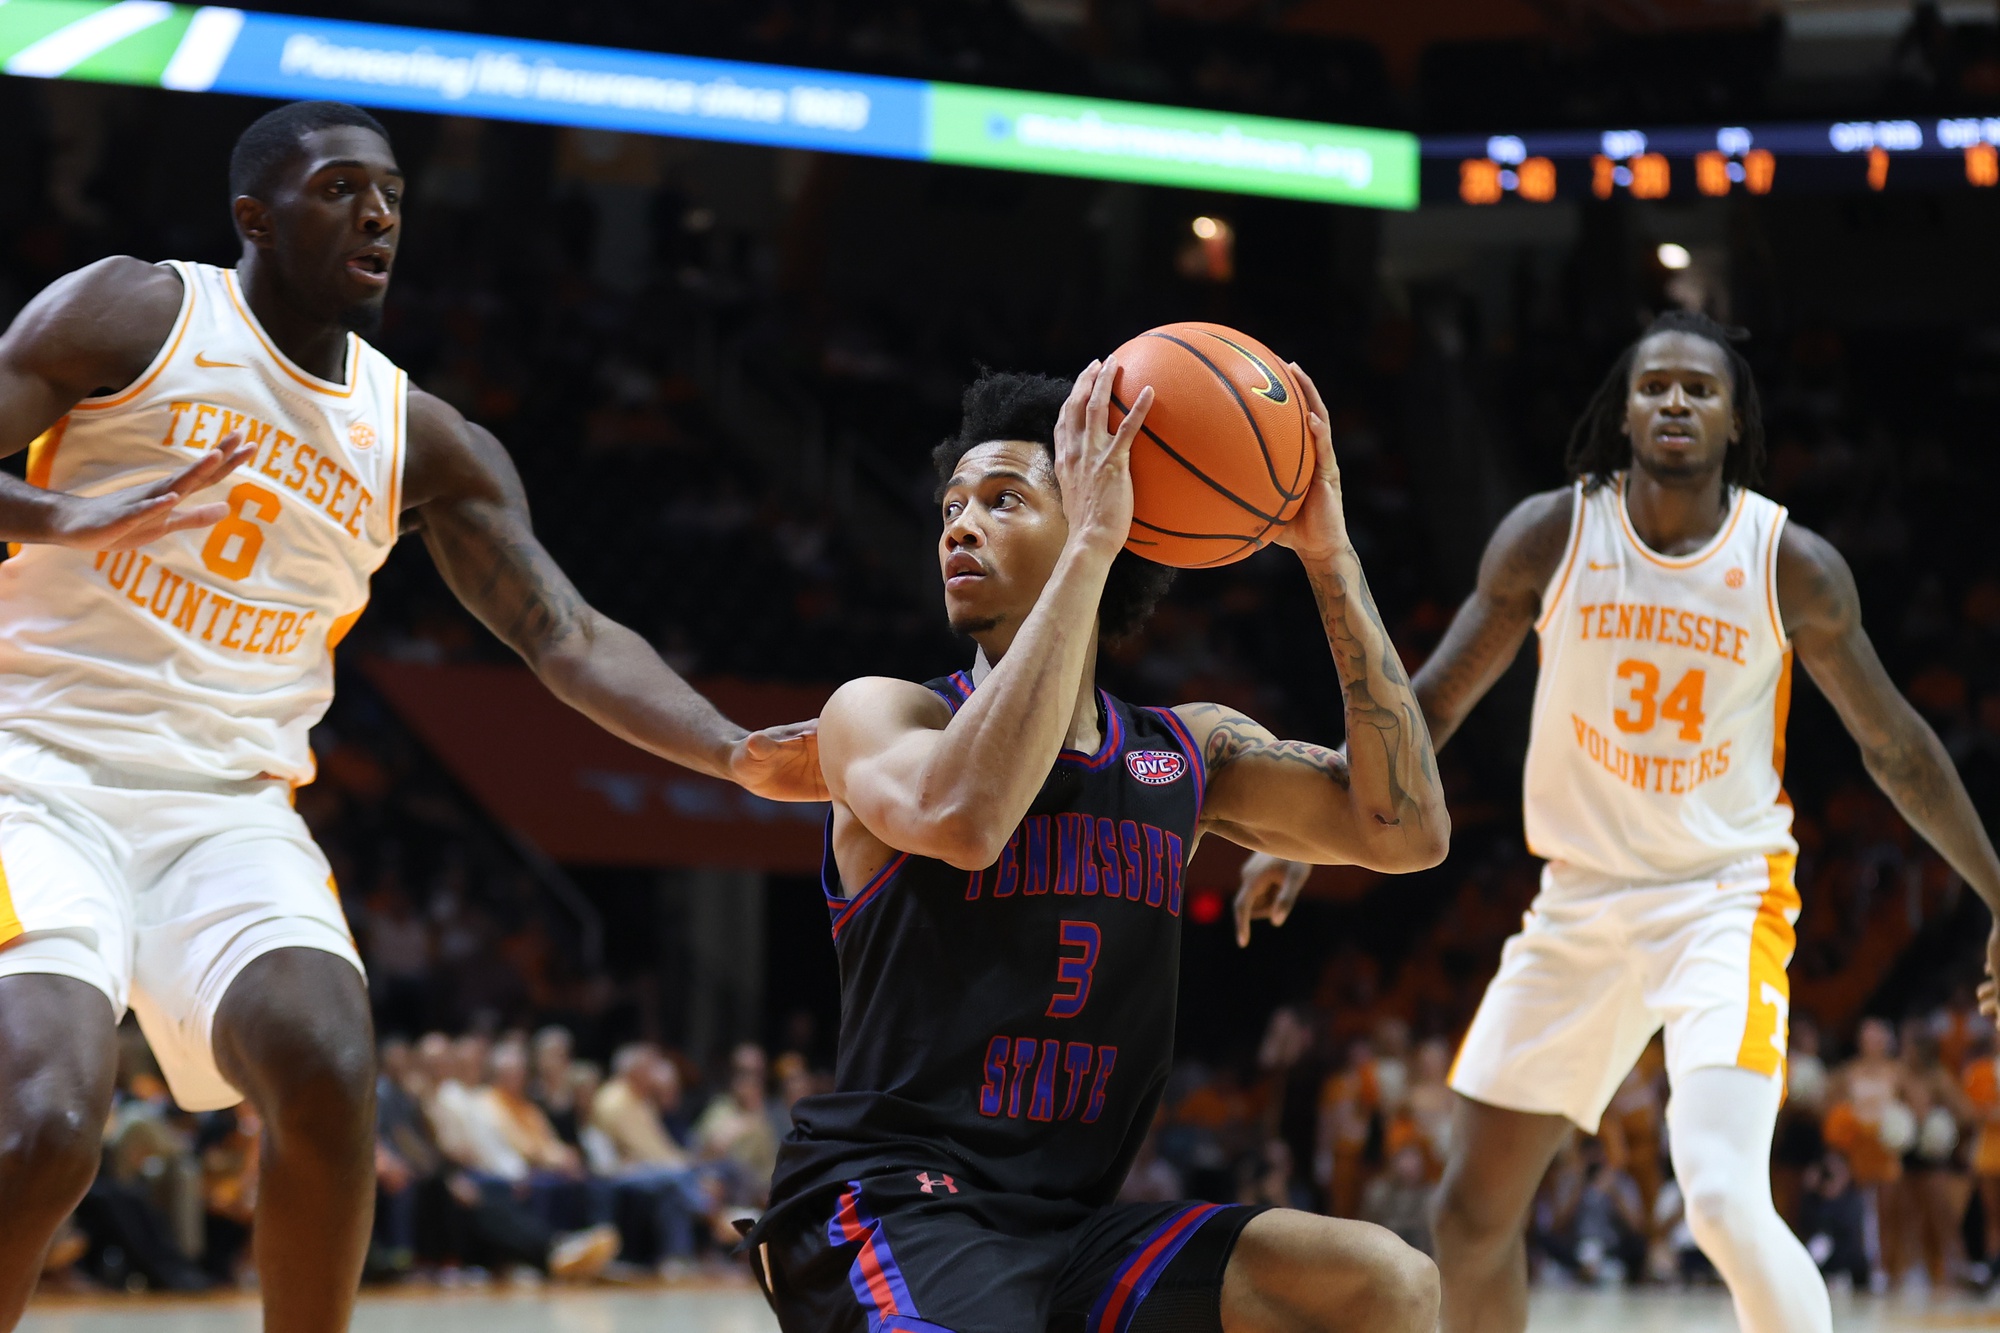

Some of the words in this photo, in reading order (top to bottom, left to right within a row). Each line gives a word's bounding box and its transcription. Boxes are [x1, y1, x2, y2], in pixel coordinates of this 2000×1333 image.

[162, 401, 373, 538] TENNESSEE
[201, 482, 282, 582] 6
[1580, 603, 1749, 666] TENNESSEE
[1613, 658, 1707, 744] 34
[1136, 759, 1171, 774] OVC
[1571, 713, 1732, 795] VOLUNTEERS
[1045, 919, 1101, 1019] 3
[979, 1035, 1118, 1123] STATE
